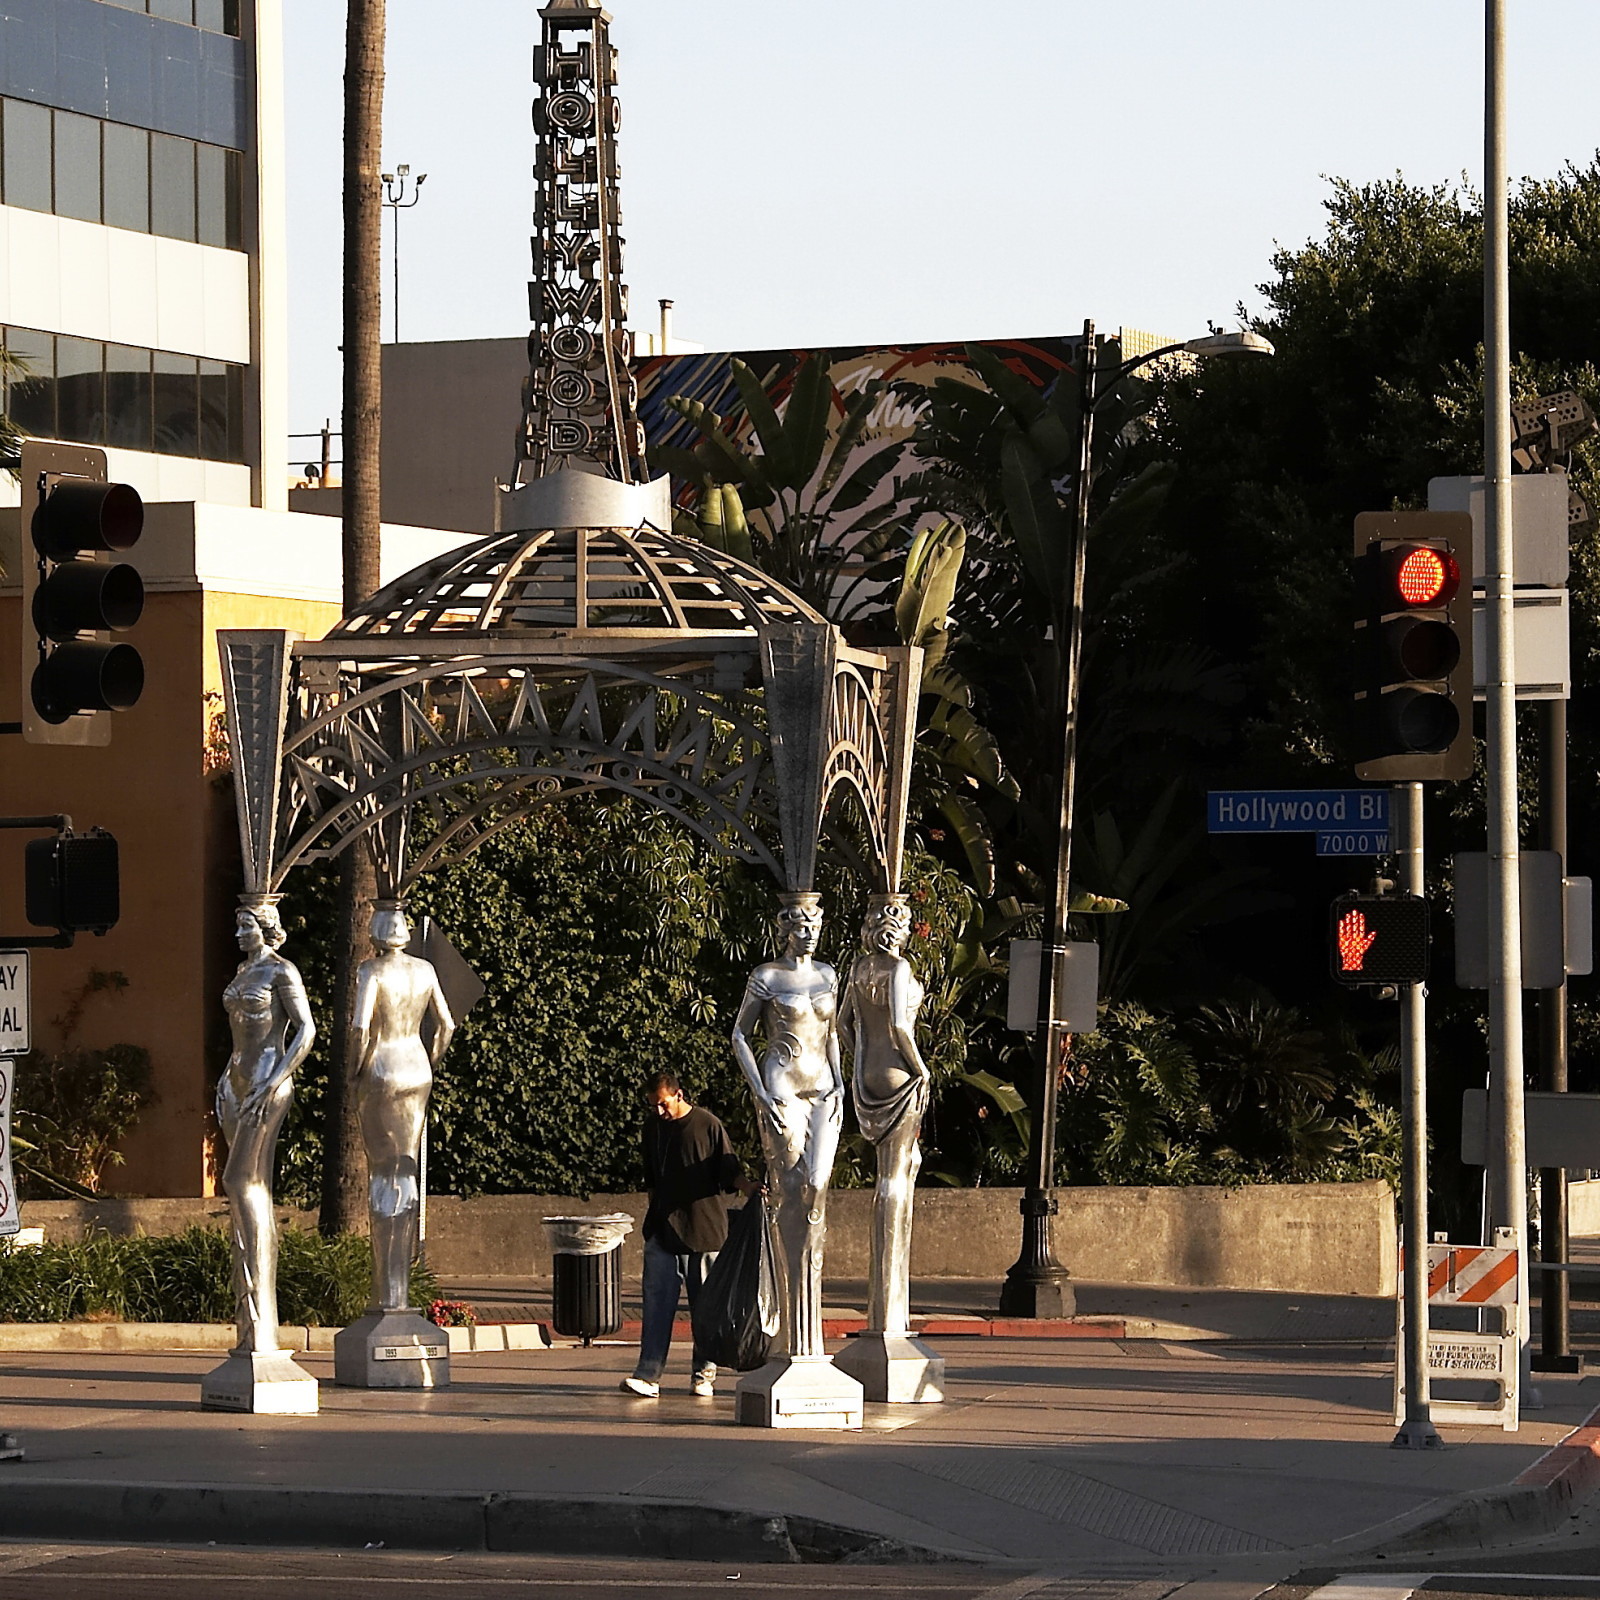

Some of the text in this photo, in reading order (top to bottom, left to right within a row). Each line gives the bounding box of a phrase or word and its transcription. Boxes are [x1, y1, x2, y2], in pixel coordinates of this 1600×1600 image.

[545, 41, 602, 456] HOLLYWOOD
[1218, 794, 1383, 829] Hollywood Bl
[1321, 834, 1388, 853] 7000 W
[0, 1006, 22, 1032] AL
[1428, 1359, 1497, 1370] REET SERVICES
